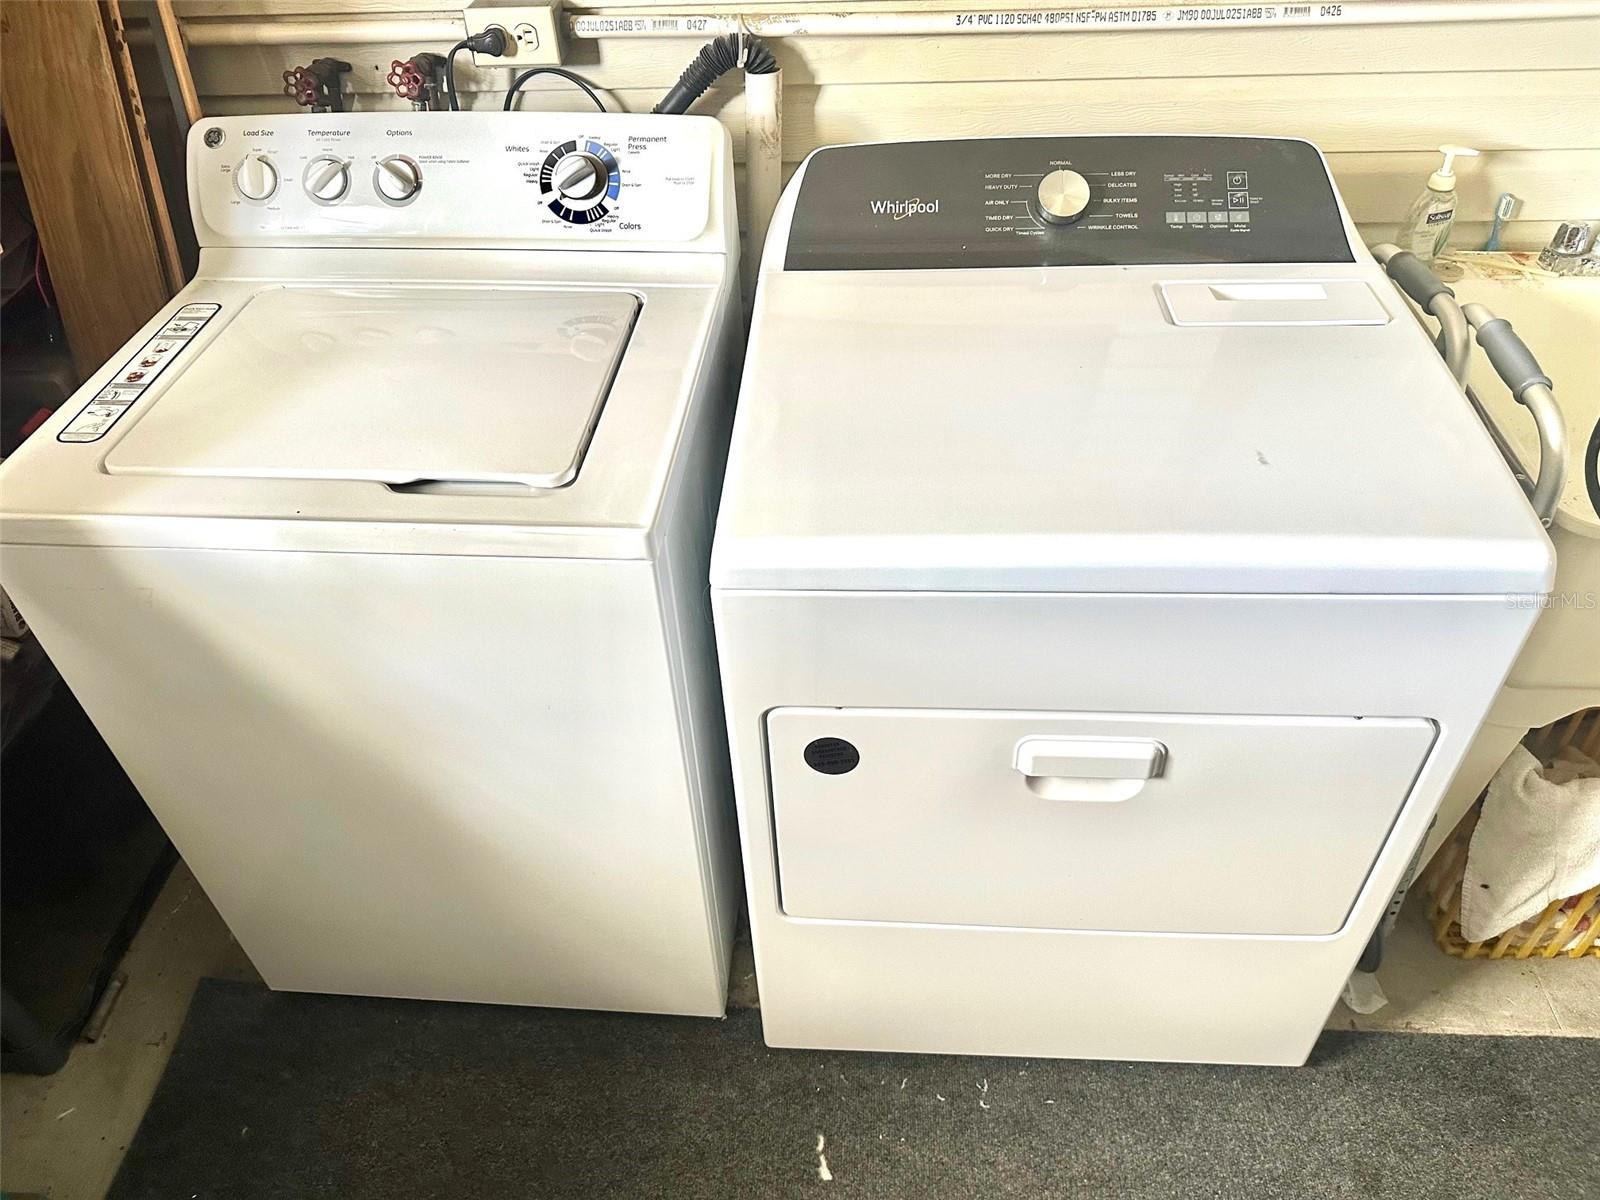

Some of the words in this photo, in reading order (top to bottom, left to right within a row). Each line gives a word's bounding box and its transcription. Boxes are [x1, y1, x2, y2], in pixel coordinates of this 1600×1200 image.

[978, 14, 993, 25] PVC
[995, 14, 1015, 25] 1120
[1016, 13, 1042, 24] SCH40
[1076, 10, 1107, 23] NSF-PW
[1108, 10, 1130, 22] ASTM
[1131, 10, 1157, 22] D1785
[1320, 5, 1342, 17] 0426
[686, 19, 707, 31] 0427
[243, 129, 259, 137] Load
[307, 129, 351, 137] Temperature
[386, 129, 413, 137] Options
[628, 135, 667, 143] Permanent
[505, 145, 530, 153] Whites
[870, 199, 939, 217] Whirlpool
[619, 222, 642, 230] Colors
